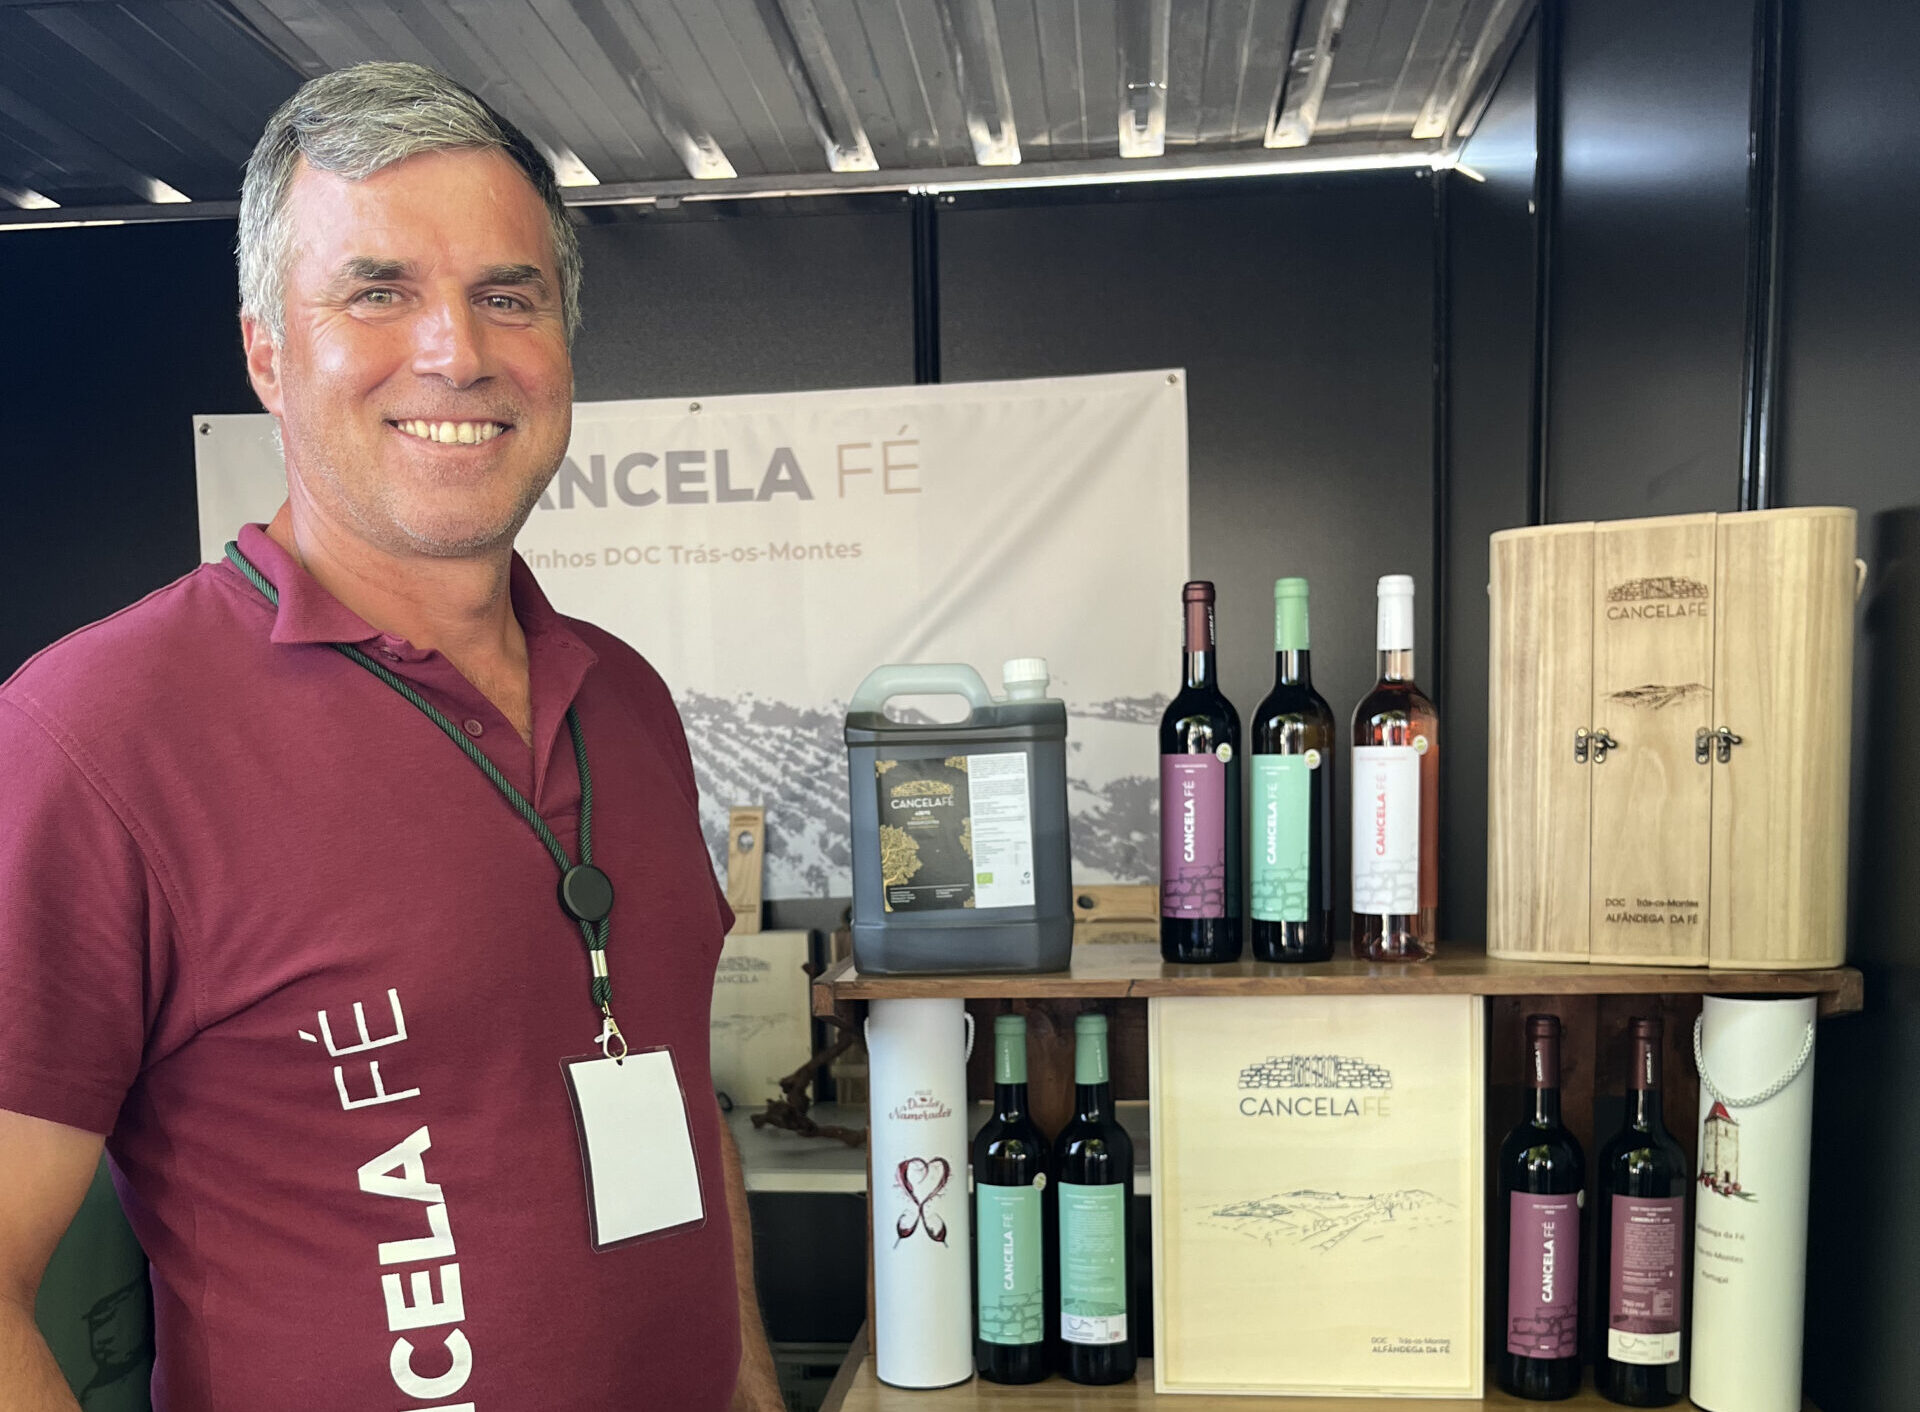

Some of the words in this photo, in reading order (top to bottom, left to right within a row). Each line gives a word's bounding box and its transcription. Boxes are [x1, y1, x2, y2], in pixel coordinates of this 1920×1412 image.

[538, 446, 814, 511] NCELA
[836, 424, 922, 499] FÉ
[523, 546, 597, 570] inhos
[603, 545, 661, 567] DOC
[668, 541, 862, 565] Trás-os-Montes
[1183, 800, 1195, 863] CANCELA
[1266, 801, 1278, 865] CANCELA
[1375, 793, 1386, 856] CANCELA
[1670, 914, 1685, 924] DA
[297, 987, 421, 1111] FÉ
[1003, 1231, 1014, 1291] CANCELA
[1541, 1221, 1555, 1238] FÉ
[1541, 1239, 1555, 1303] CANCELA
